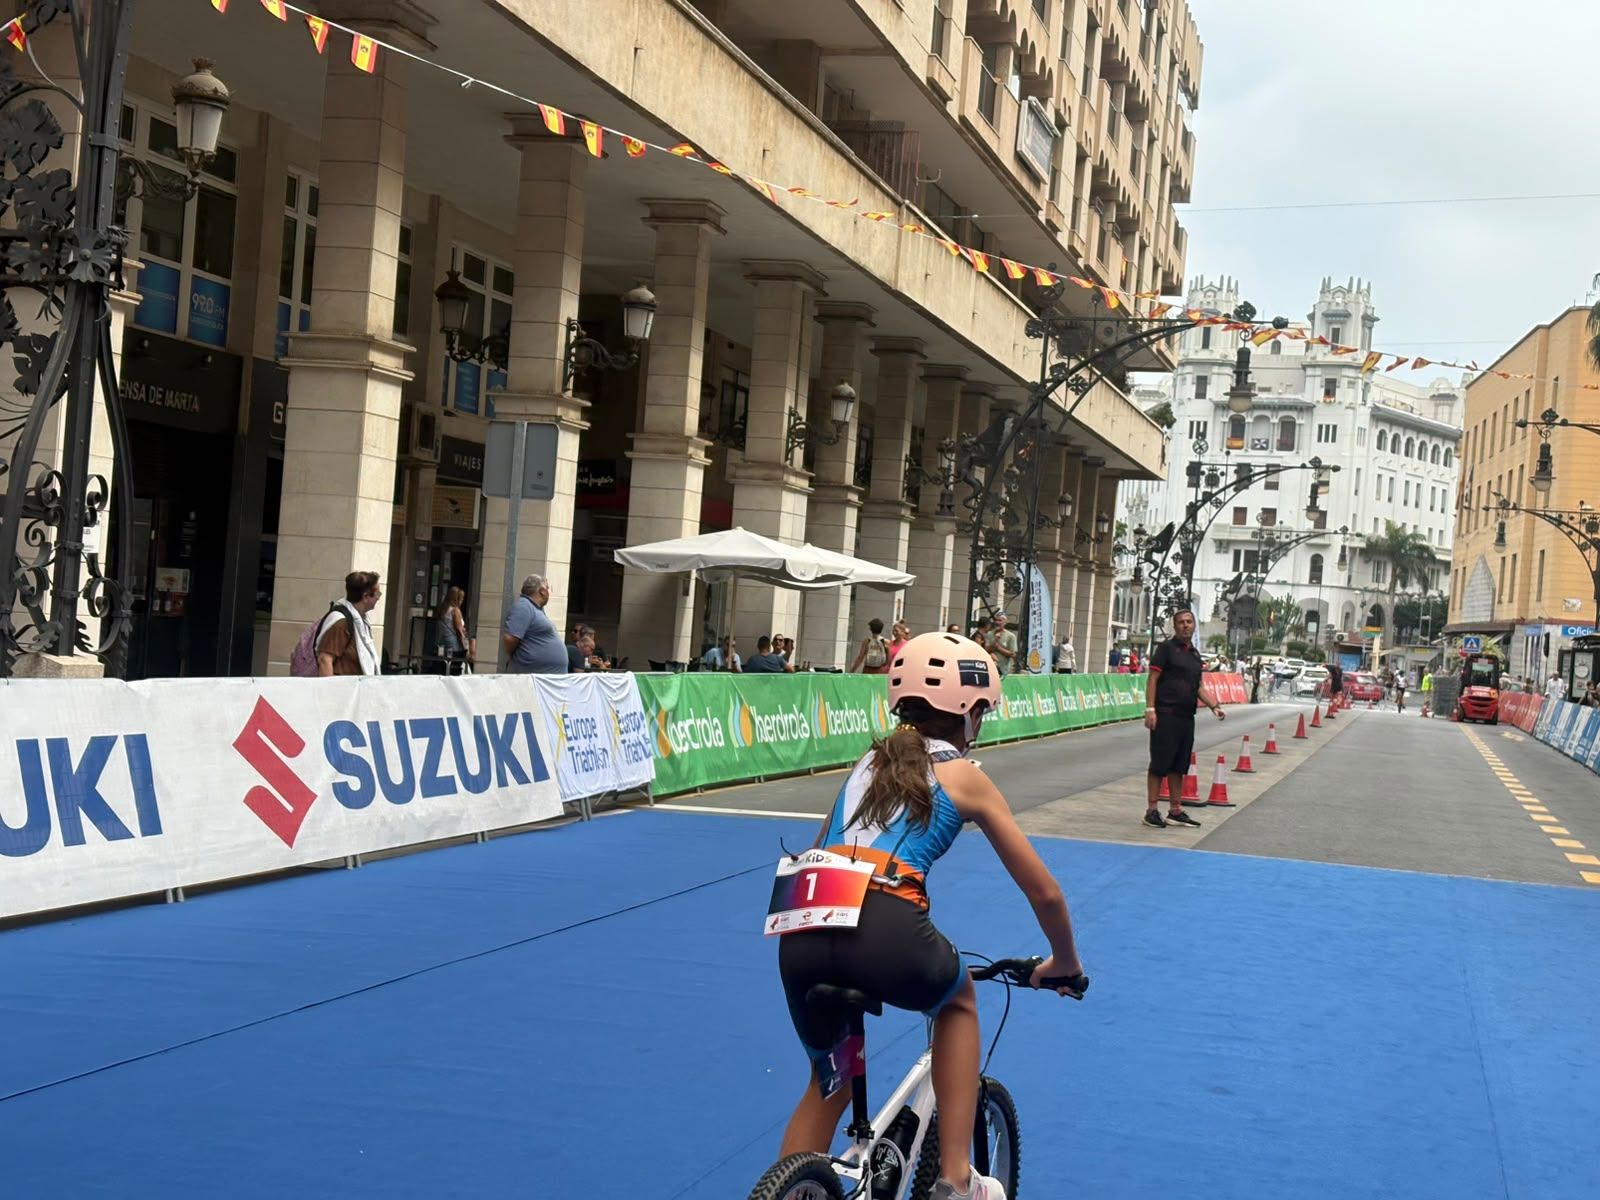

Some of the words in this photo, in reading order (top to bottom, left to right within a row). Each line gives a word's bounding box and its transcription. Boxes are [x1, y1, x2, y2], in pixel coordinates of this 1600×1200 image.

[149, 385, 164, 406] DE
[454, 454, 482, 470] VIAJES
[562, 713, 598, 742] Europe
[750, 703, 811, 744] Iberdrola
[825, 701, 870, 736] Iberdrola
[323, 712, 550, 810] SUZUKI
[805, 872, 818, 901] 1
